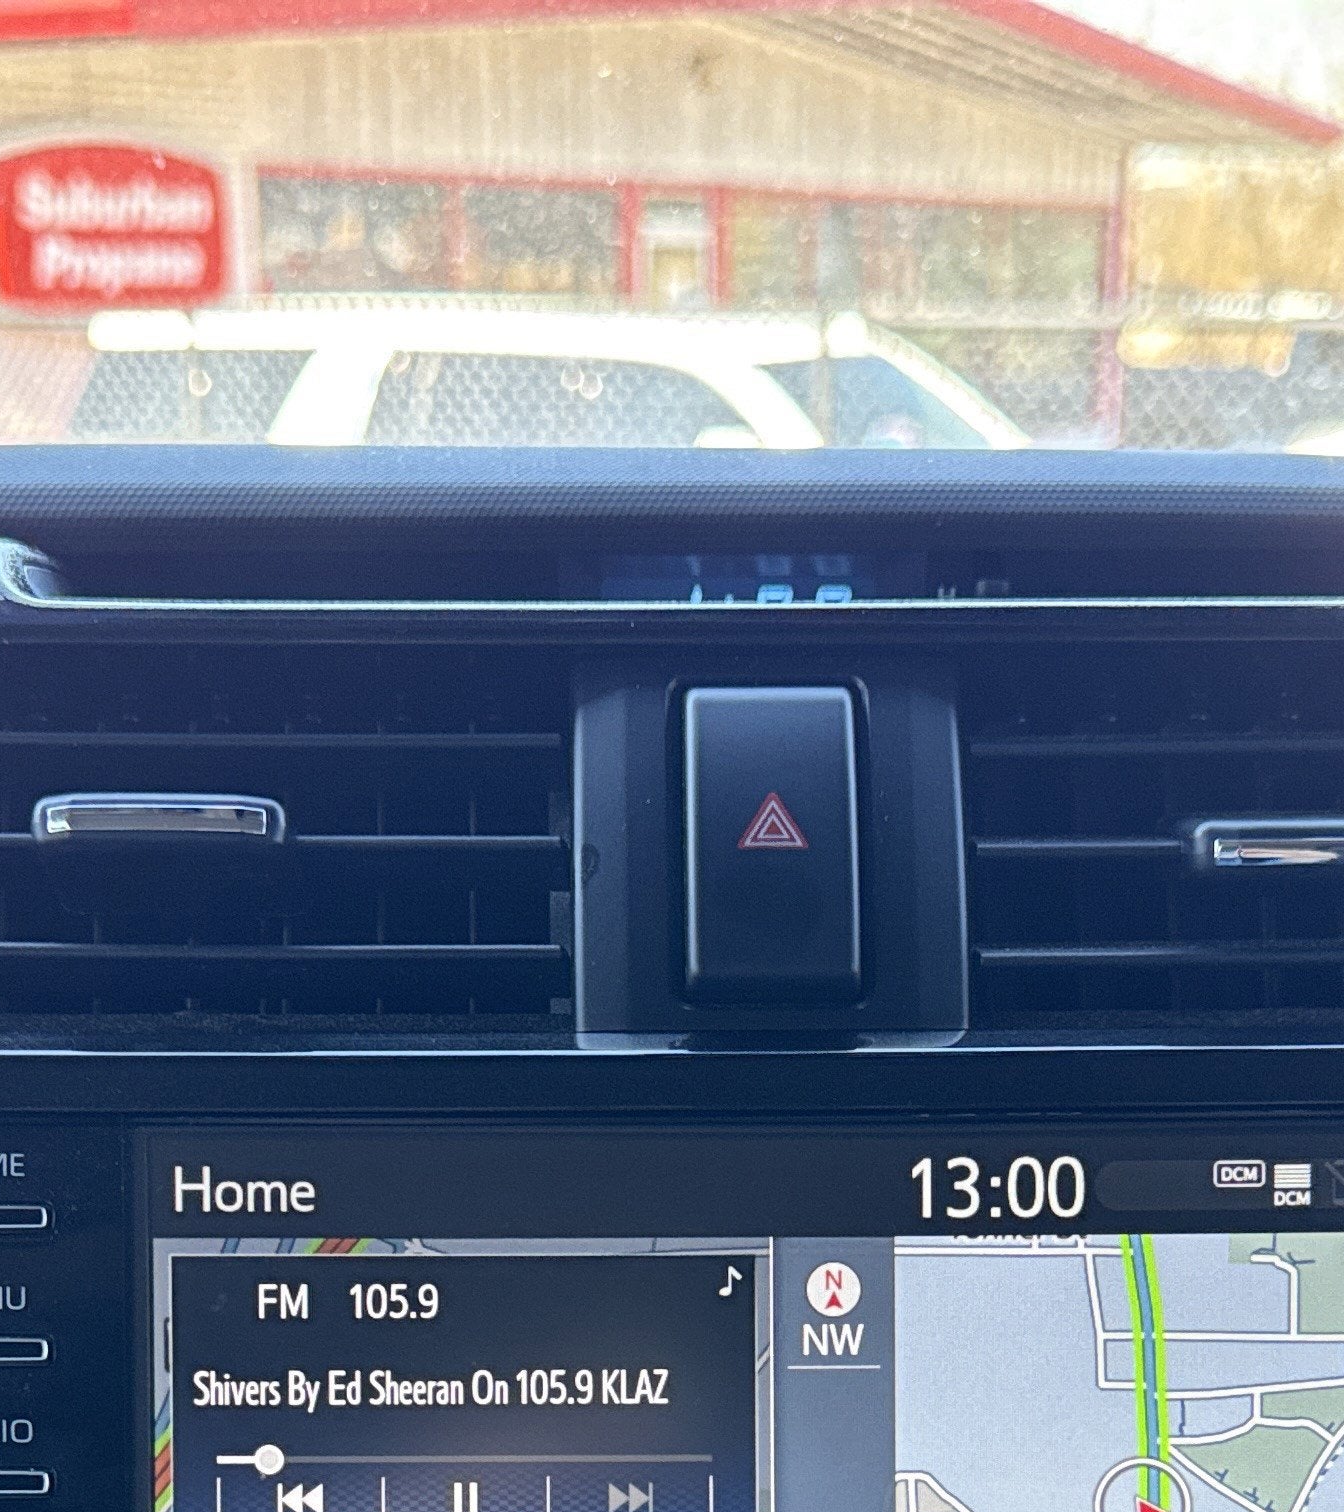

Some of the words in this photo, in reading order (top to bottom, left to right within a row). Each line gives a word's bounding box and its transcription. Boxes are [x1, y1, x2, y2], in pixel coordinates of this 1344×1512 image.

[172, 1164, 317, 1214] Home
[910, 1155, 1086, 1219] 13:00
[1220, 1166, 1258, 1182] DCM
[1273, 1190, 1311, 1206] DCM
[256, 1282, 310, 1320] FM
[347, 1282, 440, 1320] 105.9
[801, 1322, 866, 1356] NW
[192, 1370, 281, 1407] Shivers
[287, 1370, 321, 1414] By
[327, 1369, 363, 1407] Ed
[368, 1369, 465, 1406] Sheeran
[472, 1370, 510, 1406] On
[516, 1369, 594, 1405] 105.9
[601, 1368, 670, 1405] KLAZ
